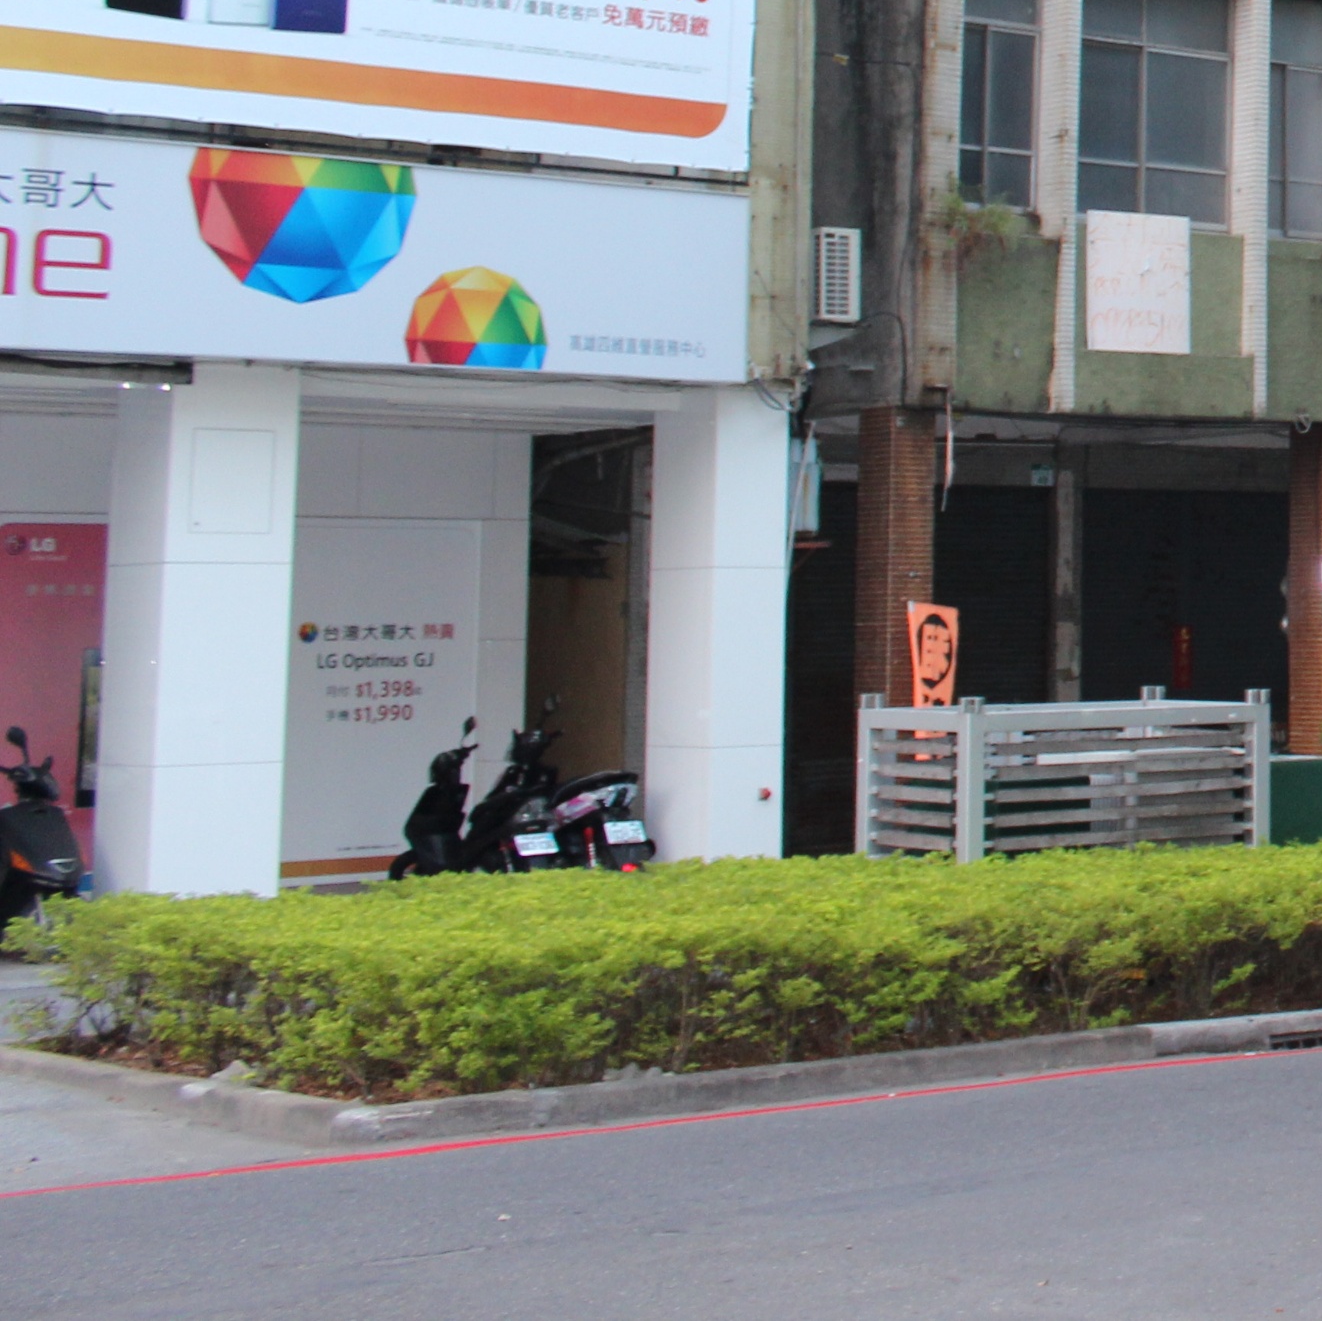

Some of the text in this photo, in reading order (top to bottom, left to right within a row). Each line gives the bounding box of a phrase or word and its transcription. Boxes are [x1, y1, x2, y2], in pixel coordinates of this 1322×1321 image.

[30, 536, 57, 552] LG
[317, 653, 337, 669] LG
[342, 653, 408, 671] Optimus
[353, 704, 413, 723] $1,990
